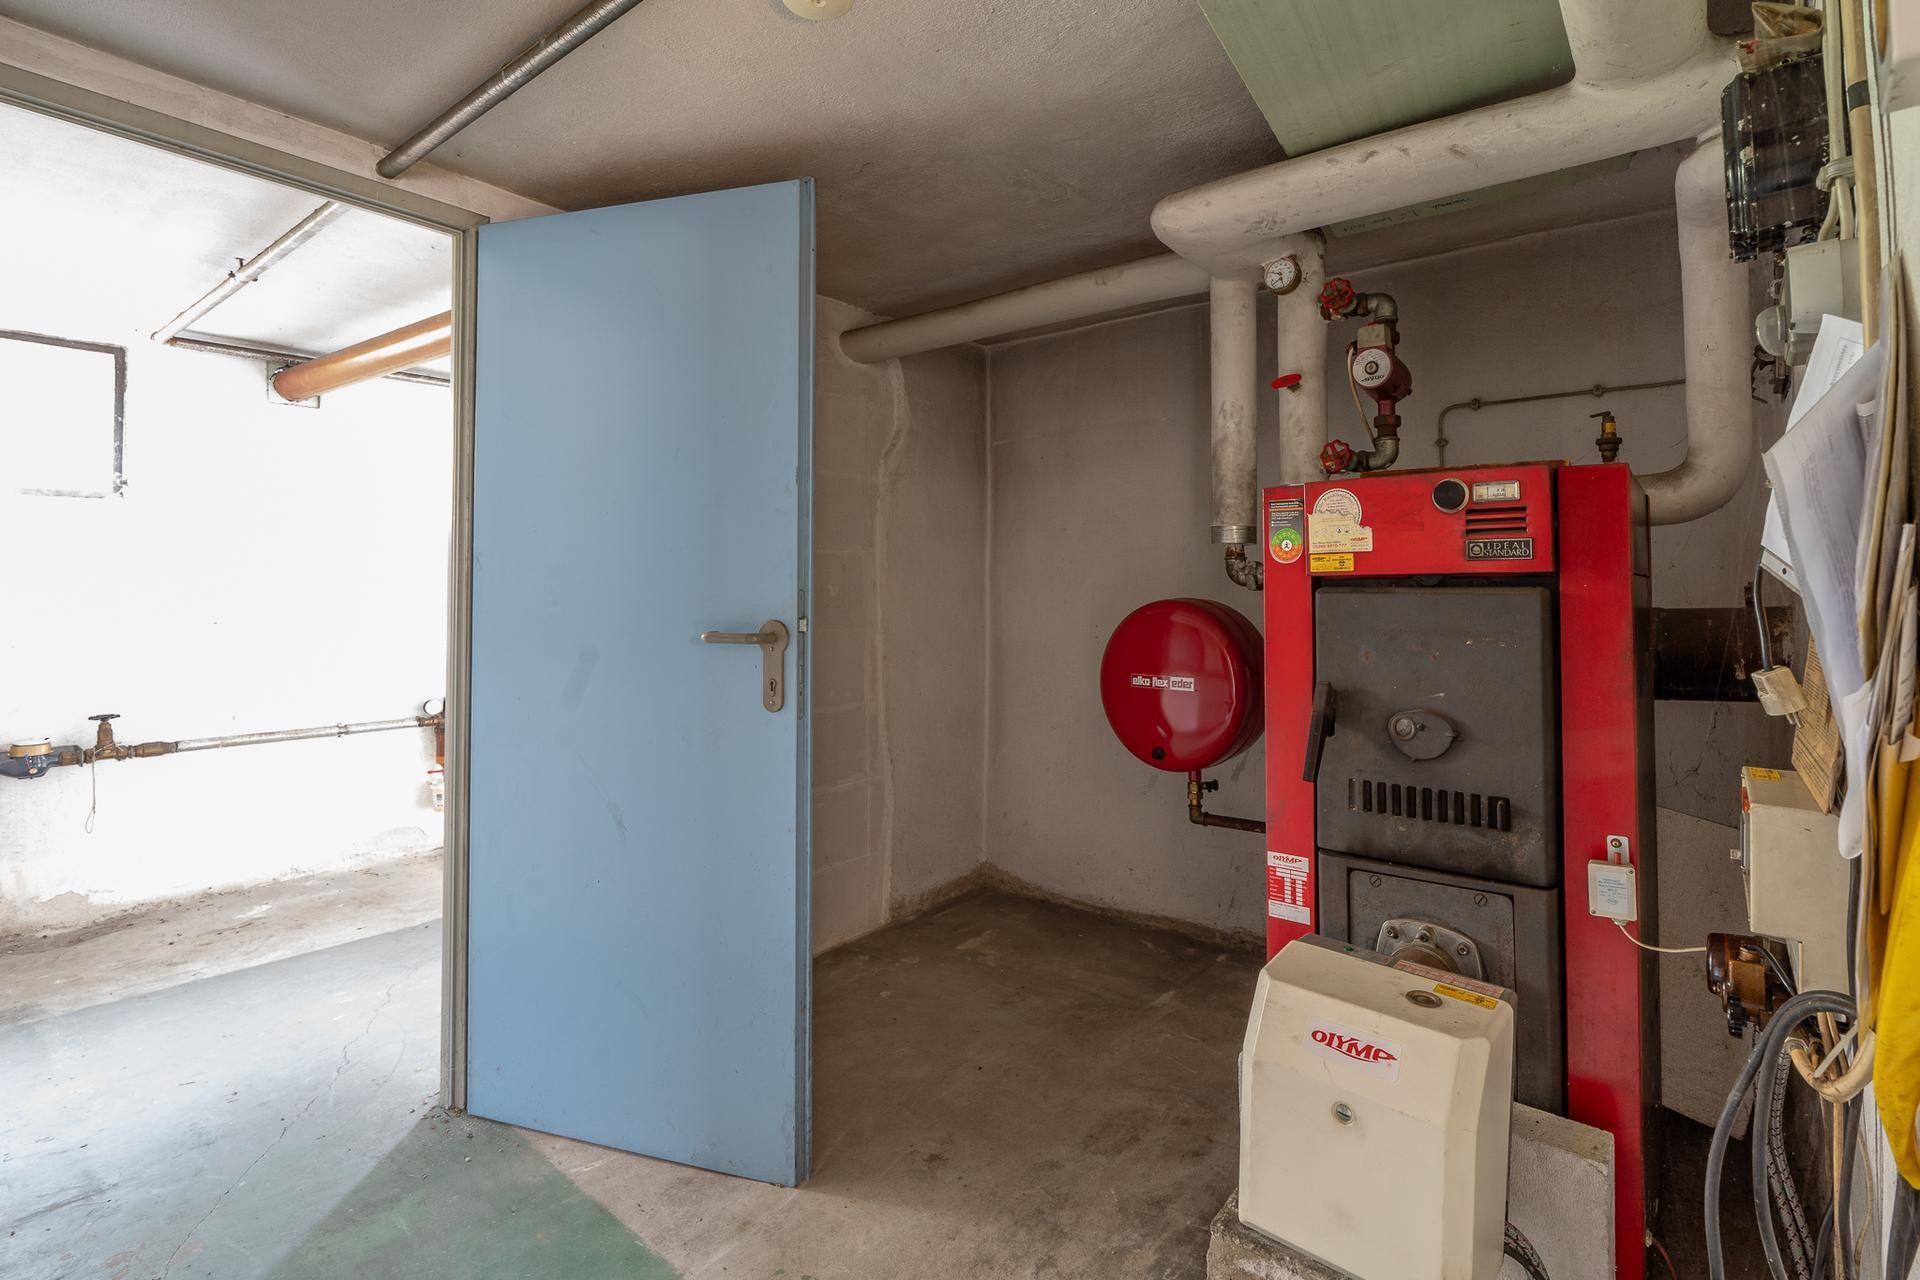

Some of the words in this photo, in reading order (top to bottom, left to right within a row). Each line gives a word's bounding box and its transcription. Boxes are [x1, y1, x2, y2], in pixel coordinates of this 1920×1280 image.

[1484, 548, 1529, 556] STANDARD
[1132, 676, 1150, 685] elko
[1172, 679, 1193, 688] eder
[1311, 1030, 1398, 1062] OLYMP
